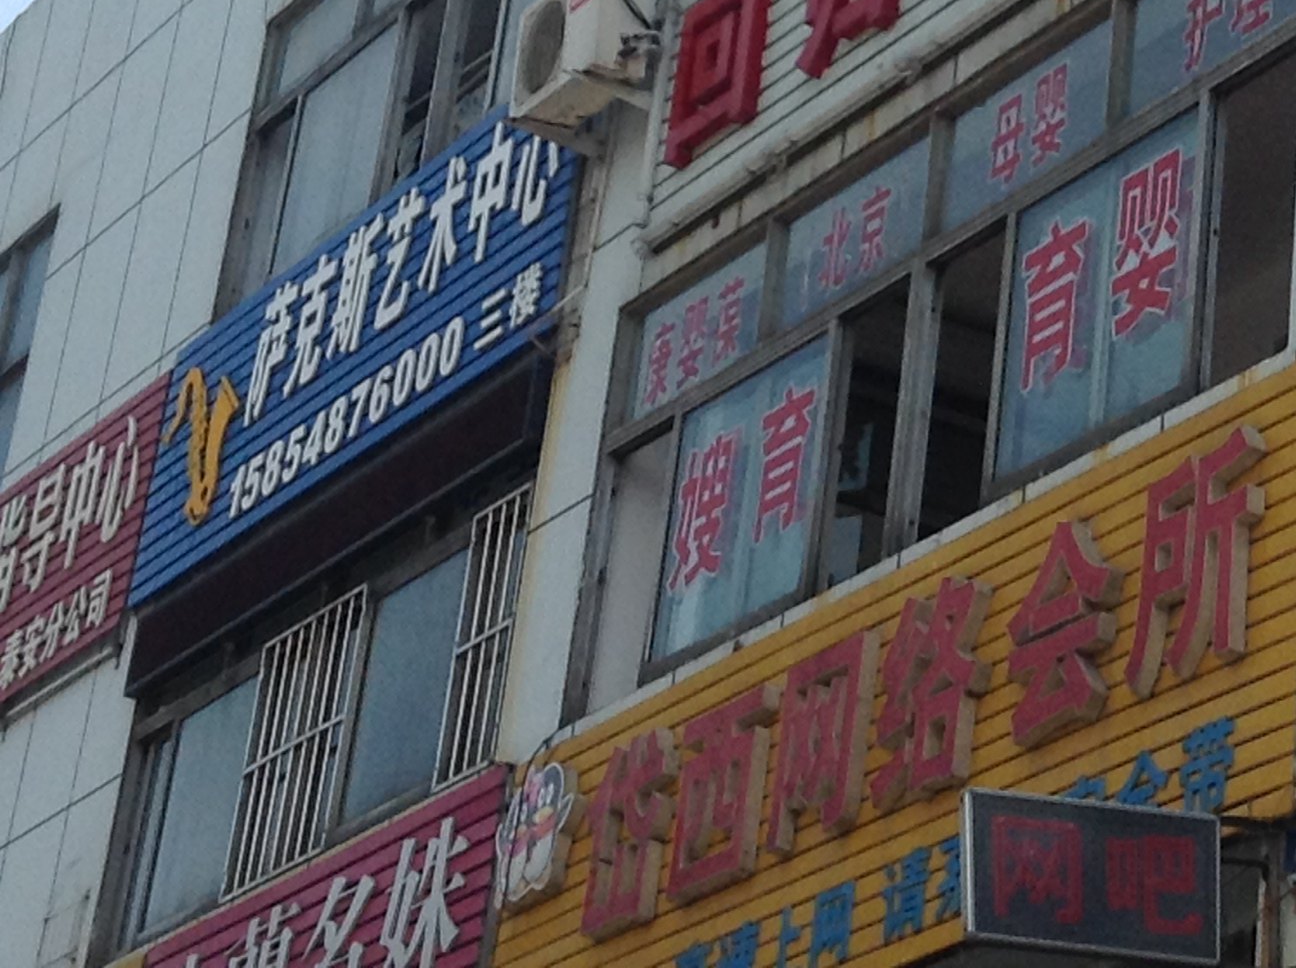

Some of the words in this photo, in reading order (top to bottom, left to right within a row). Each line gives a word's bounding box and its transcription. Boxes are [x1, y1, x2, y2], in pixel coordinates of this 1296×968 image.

[244, 122, 559, 427] 萨克斯艺术中心
[819, 186, 892, 288] 北京
[989, 61, 1069, 184] 母婴
[1021, 148, 1183, 393] 育婴
[228, 316, 466, 519] 15854876000
[473, 262, 544, 351] 三楼
[581, 427, 1267, 943] 岱西网络会所
[990, 815, 1203, 934] 网吧
